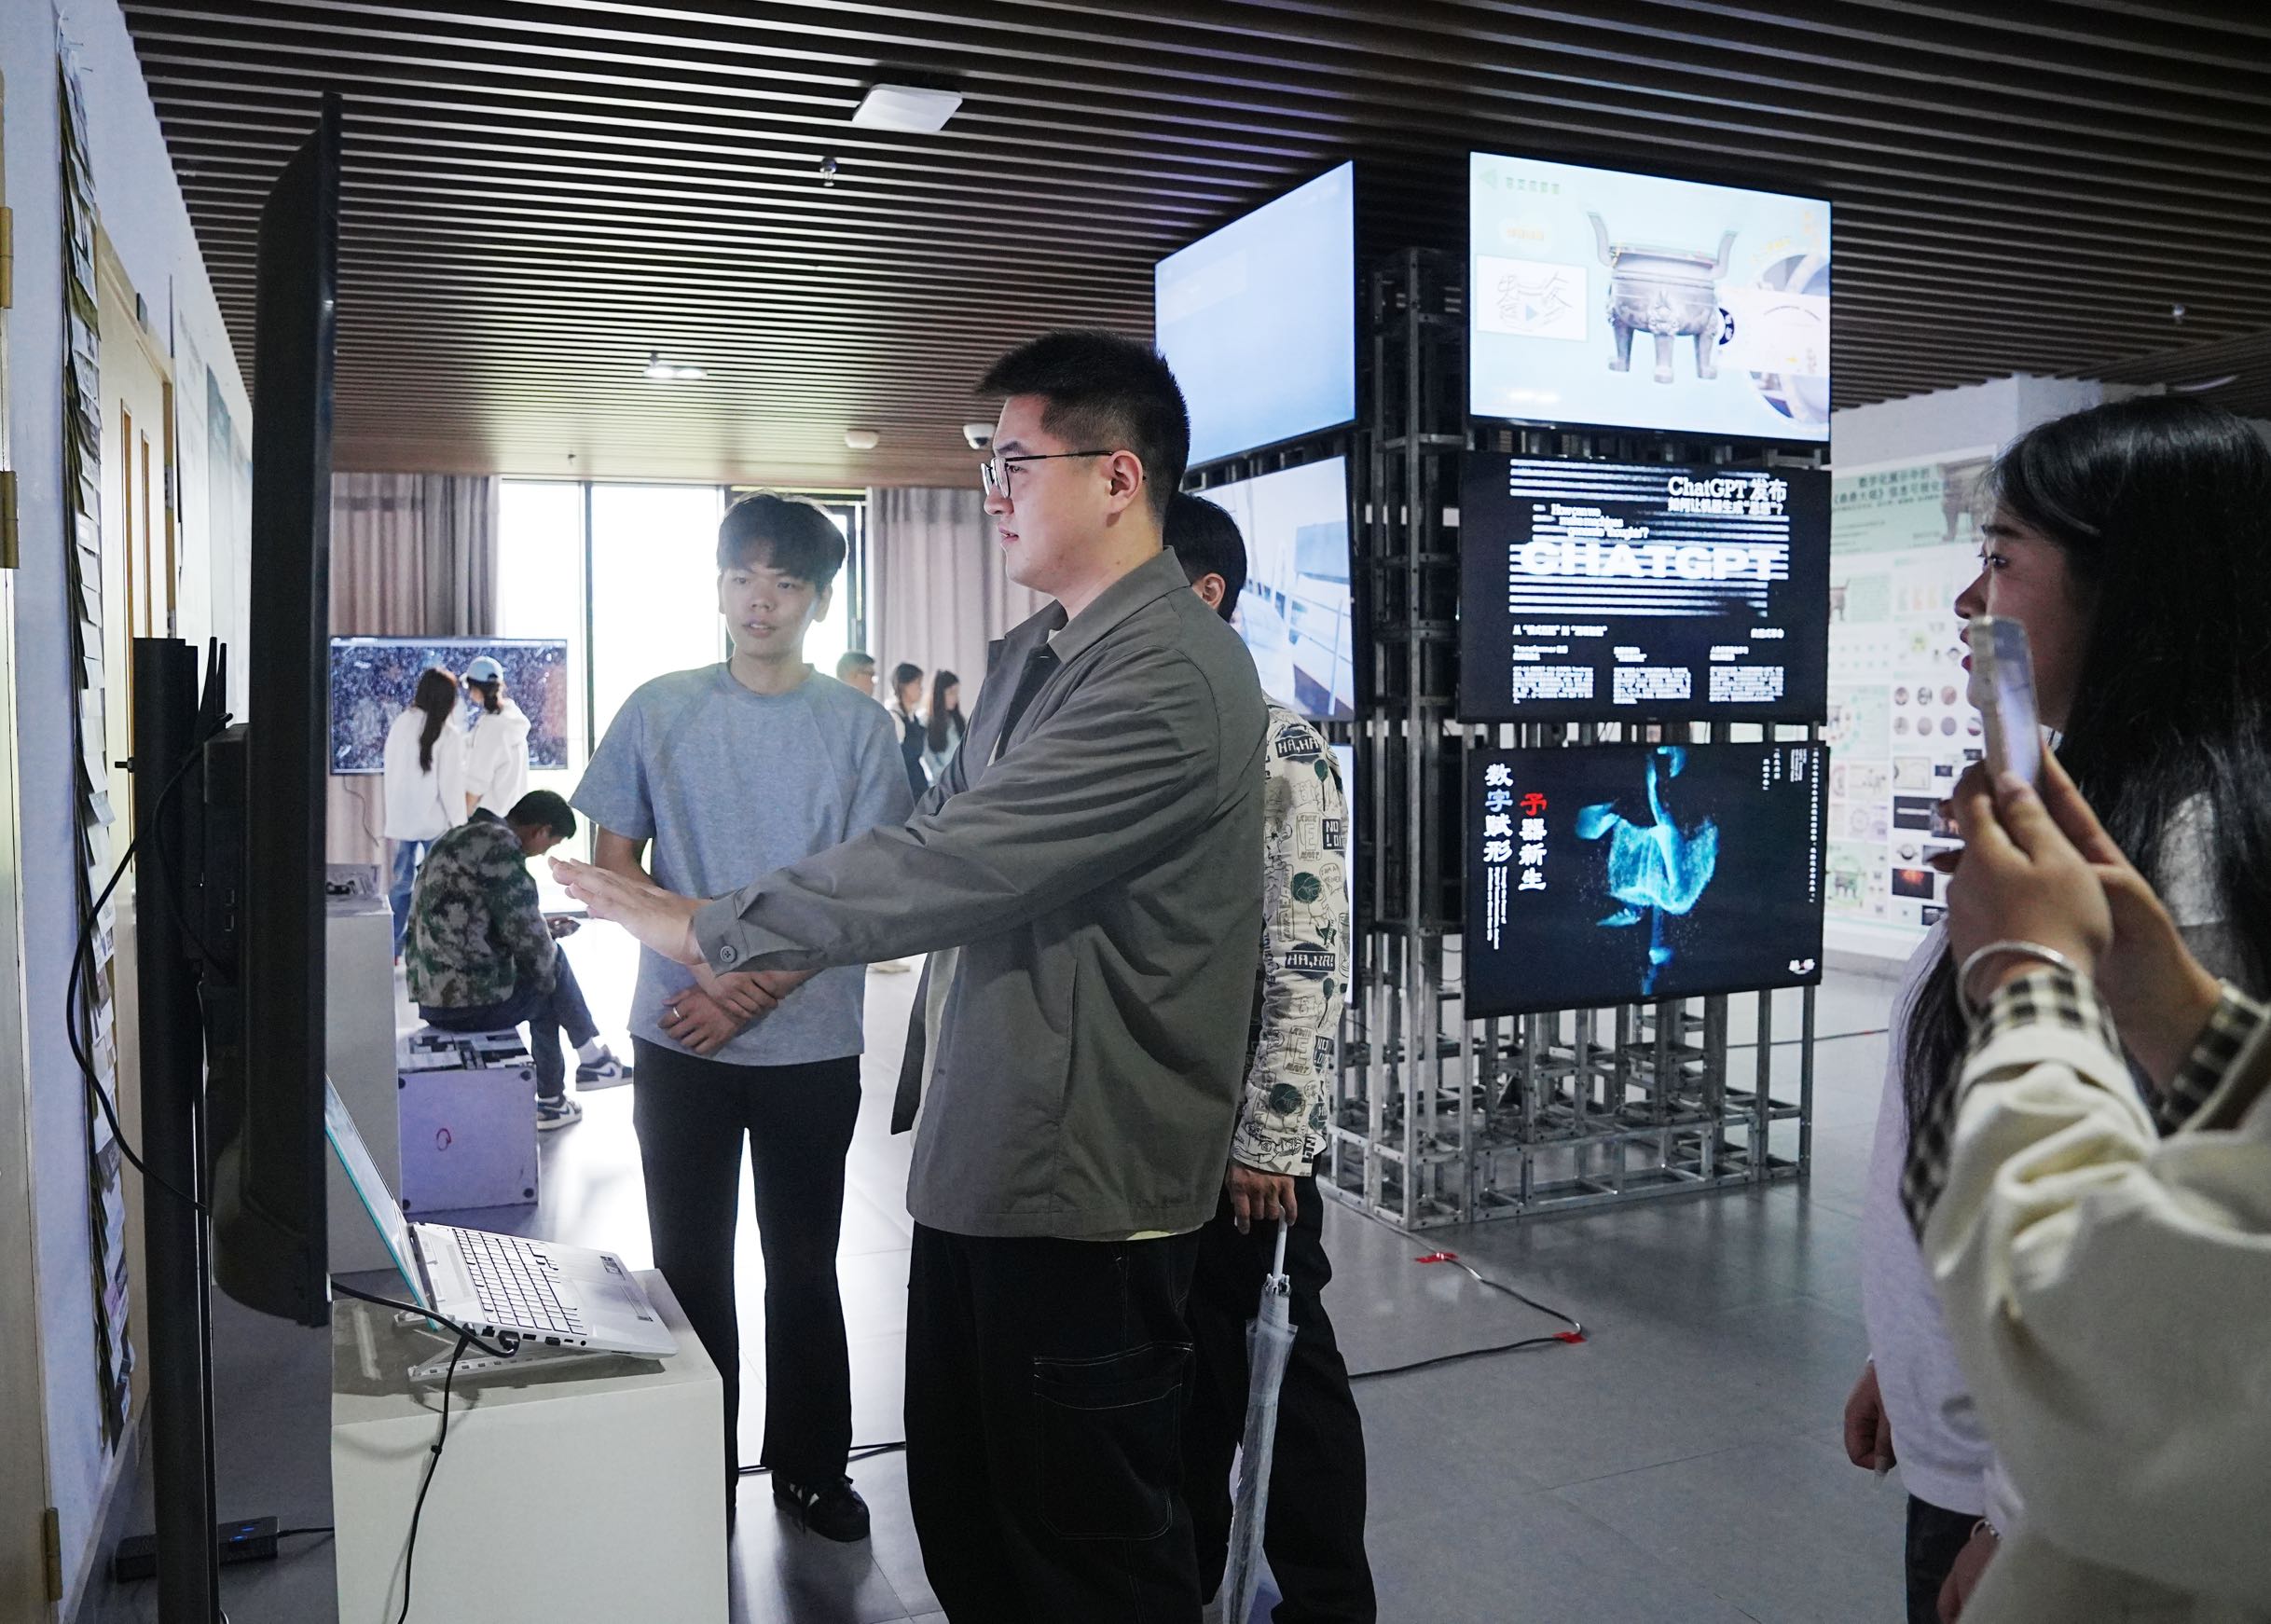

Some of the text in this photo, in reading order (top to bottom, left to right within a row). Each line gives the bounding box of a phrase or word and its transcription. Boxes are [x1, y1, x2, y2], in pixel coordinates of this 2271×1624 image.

[1668, 476, 1788, 502] ChatGPT 发布
[1520, 541, 1780, 582] CHATGPT
[1483, 764, 1514, 862] 数字赋形
[1518, 792, 1548, 890] 予器新生
[1287, 954, 1334, 968] HA,HA!
